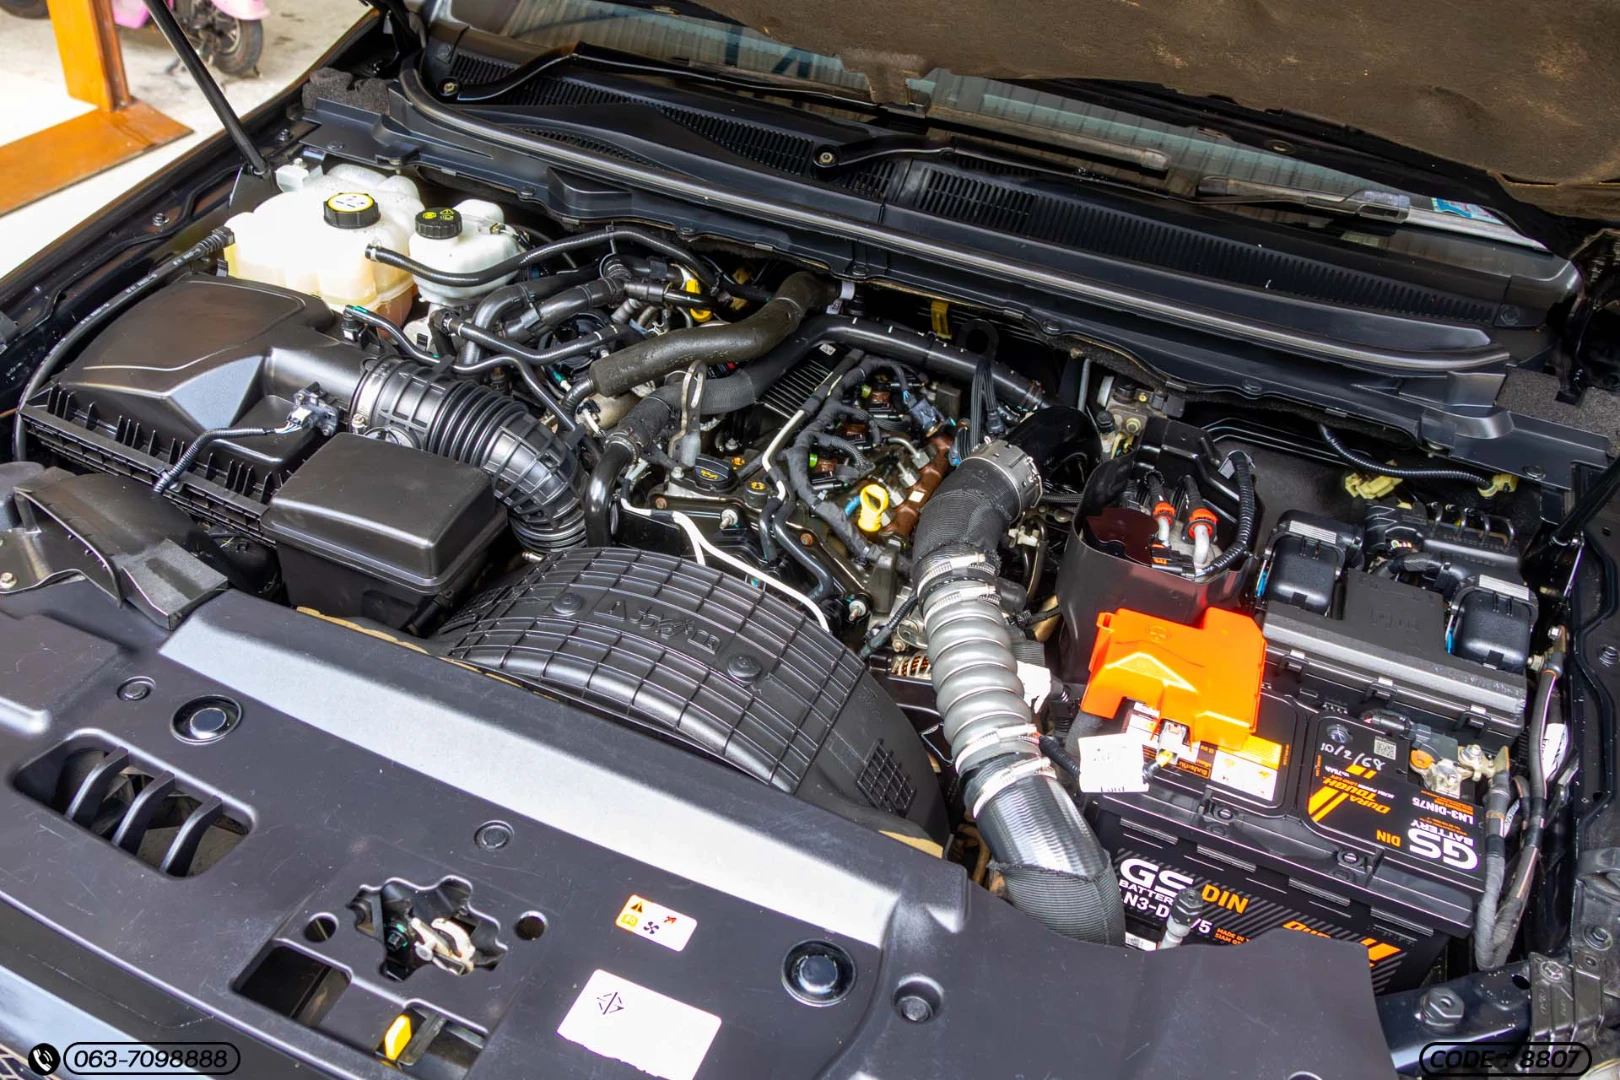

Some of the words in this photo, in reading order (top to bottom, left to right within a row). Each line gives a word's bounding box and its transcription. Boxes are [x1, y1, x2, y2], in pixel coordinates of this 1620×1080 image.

[1323, 778, 1377, 802] TOUGH
[1349, 794, 1391, 815] DURA
[1412, 797, 1474, 825] LN3-DIN75
[1376, 829, 1401, 848] DIN
[1411, 819, 1474, 847] BATTERY
[1408, 828, 1478, 870] GS
[1120, 858, 1194, 898] GS
[1119, 879, 1175, 907] BATTER
[1201, 883, 1249, 914] DIN
[1216, 927, 1236, 939] MADE
